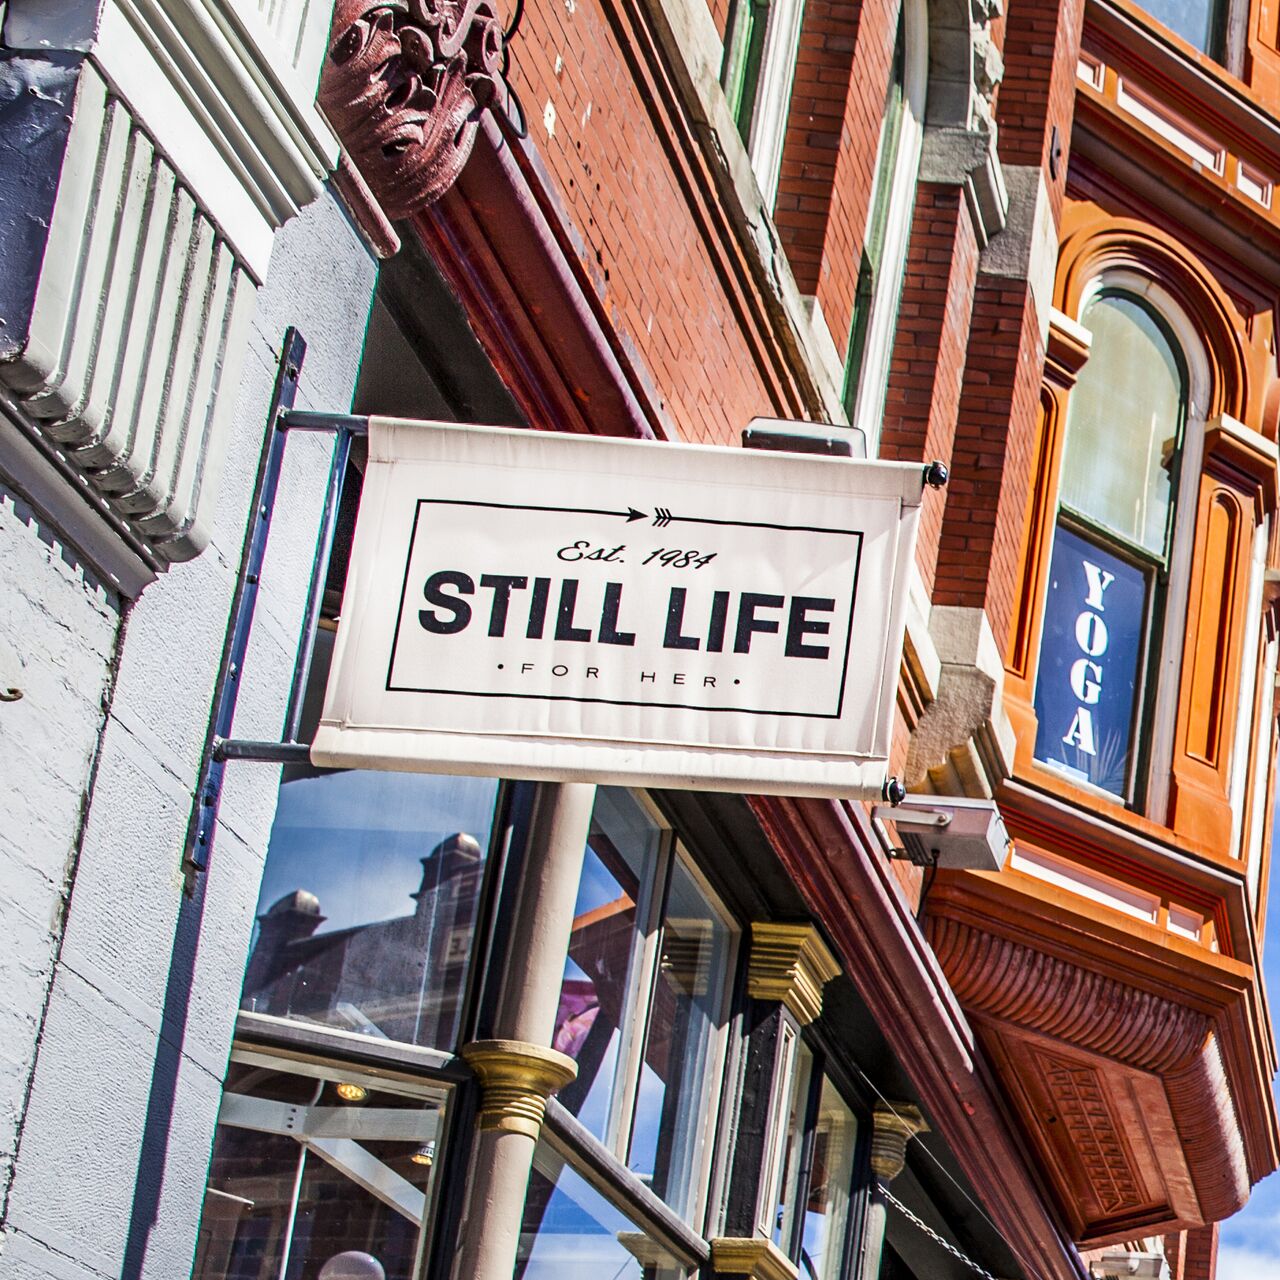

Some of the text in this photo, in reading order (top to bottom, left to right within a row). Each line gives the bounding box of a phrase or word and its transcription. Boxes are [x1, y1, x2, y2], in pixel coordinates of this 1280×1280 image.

[556, 540, 719, 570] Est. 1984
[418, 570, 837, 660] STILL LIFE
[520, 663, 717, 688] FOR HER
[1063, 560, 1115, 756] YOGA
